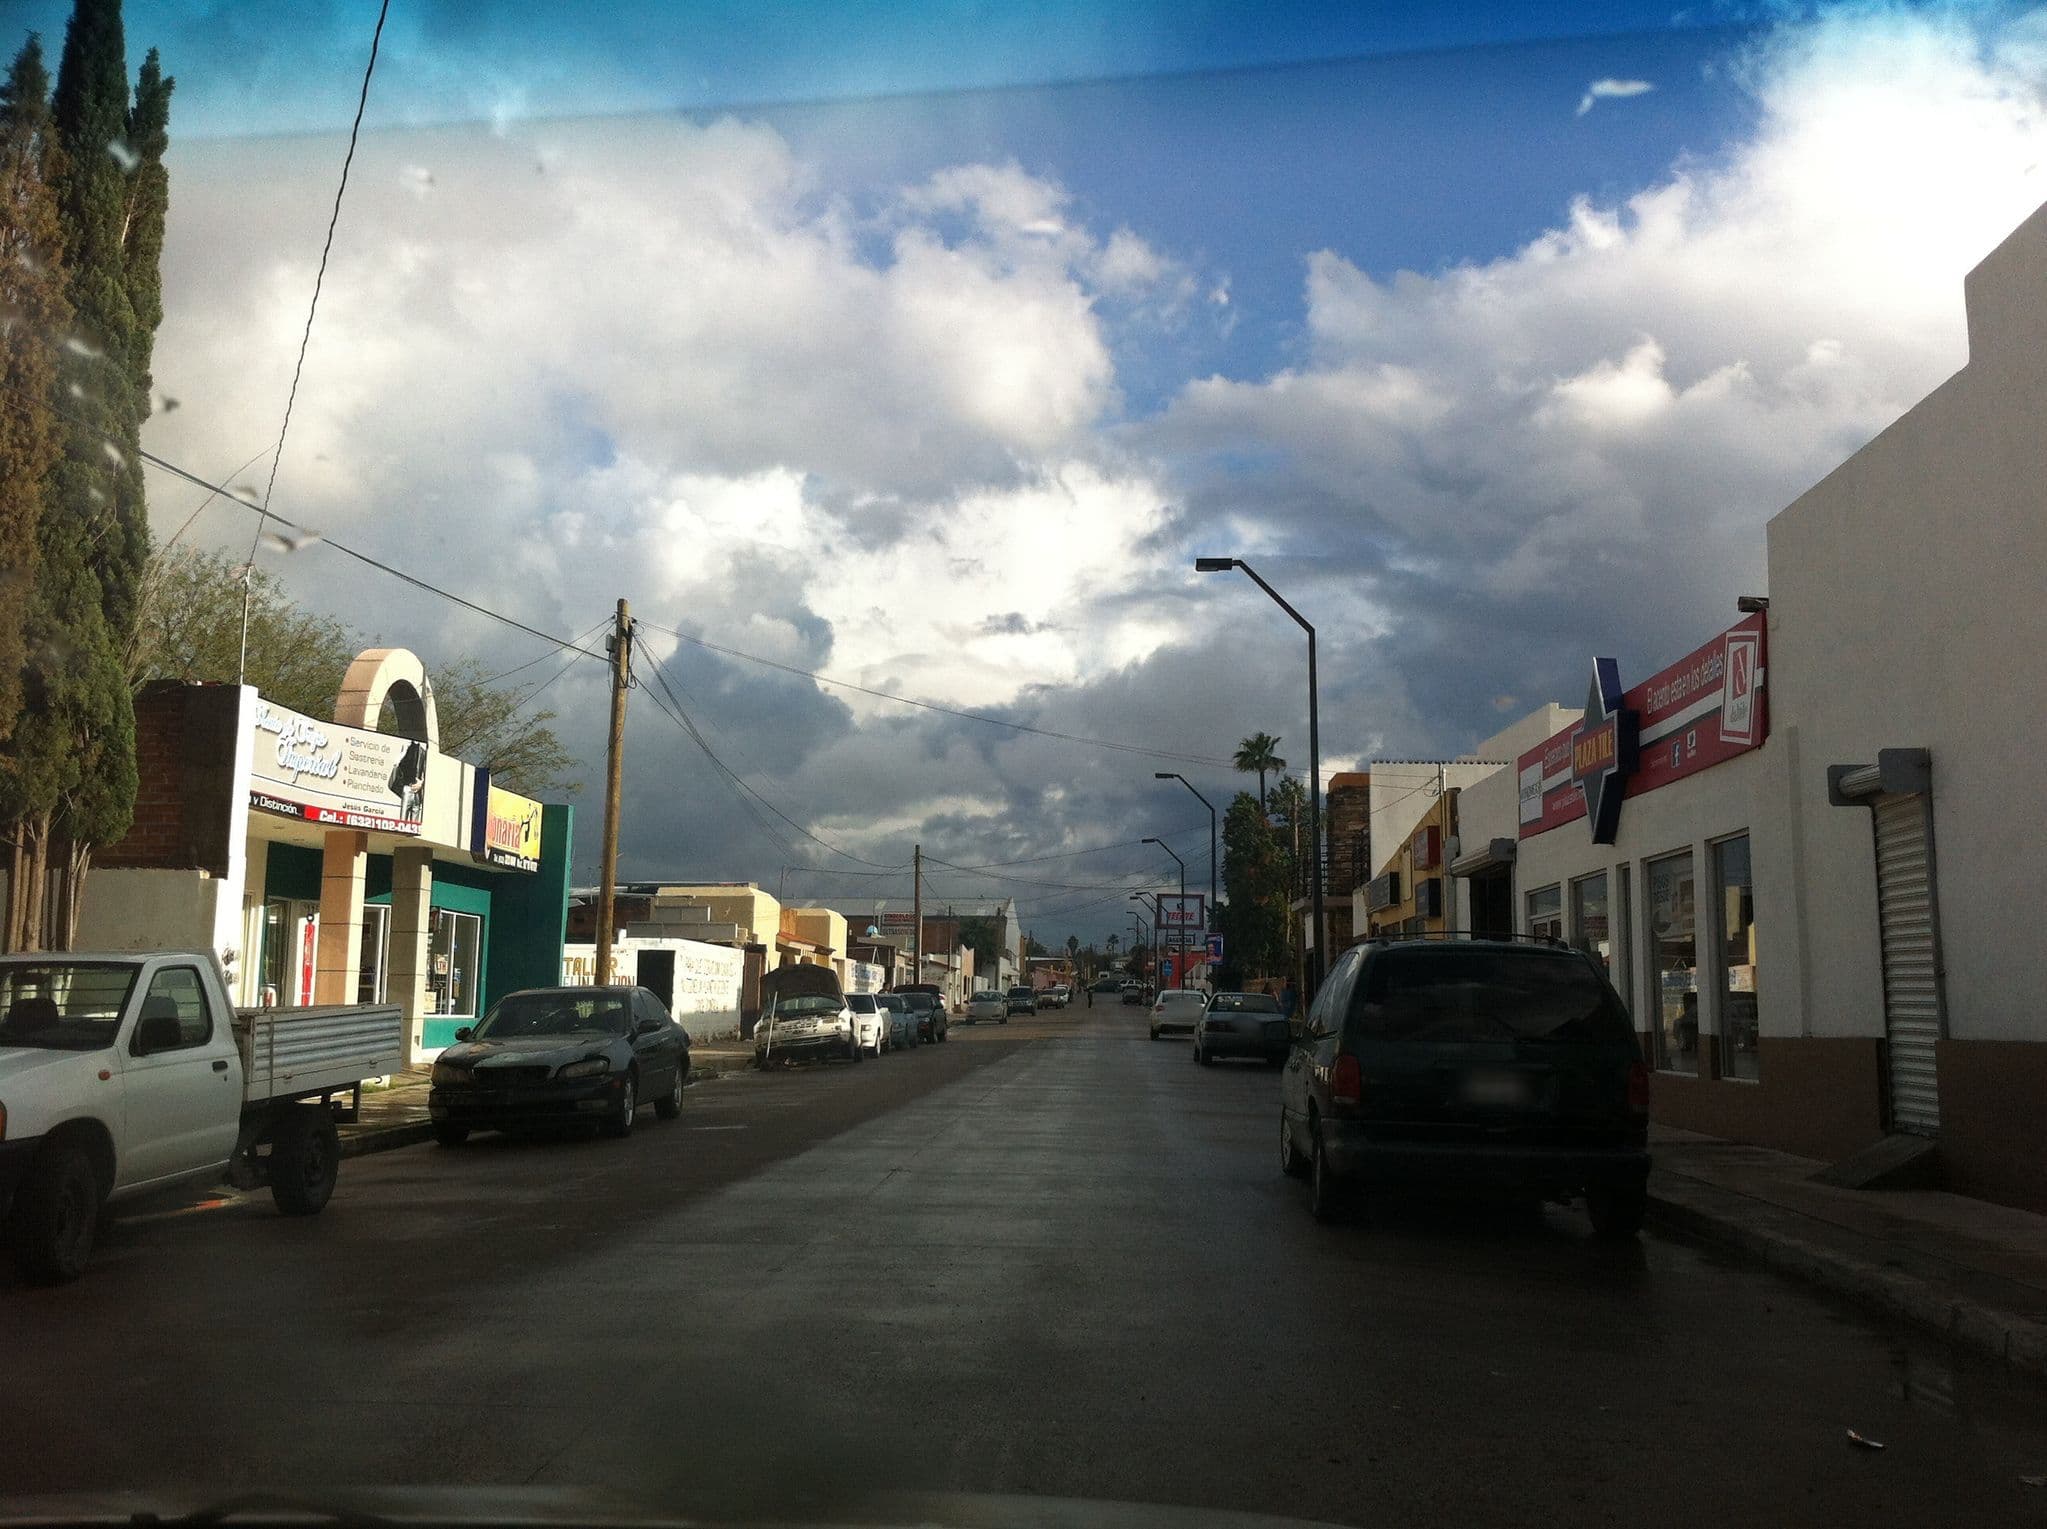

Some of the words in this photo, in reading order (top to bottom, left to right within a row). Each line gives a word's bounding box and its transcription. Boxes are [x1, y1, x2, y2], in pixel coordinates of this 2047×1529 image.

[350, 736, 380, 752] Servicio
[381, 744, 391, 754] de
[1574, 737, 1597, 772] PLAZA
[1598, 729, 1613, 760] TILE
[347, 778, 385, 794] Planchado
[1168, 936, 1193, 944] AGENIA
[563, 957, 618, 977] TALLR
